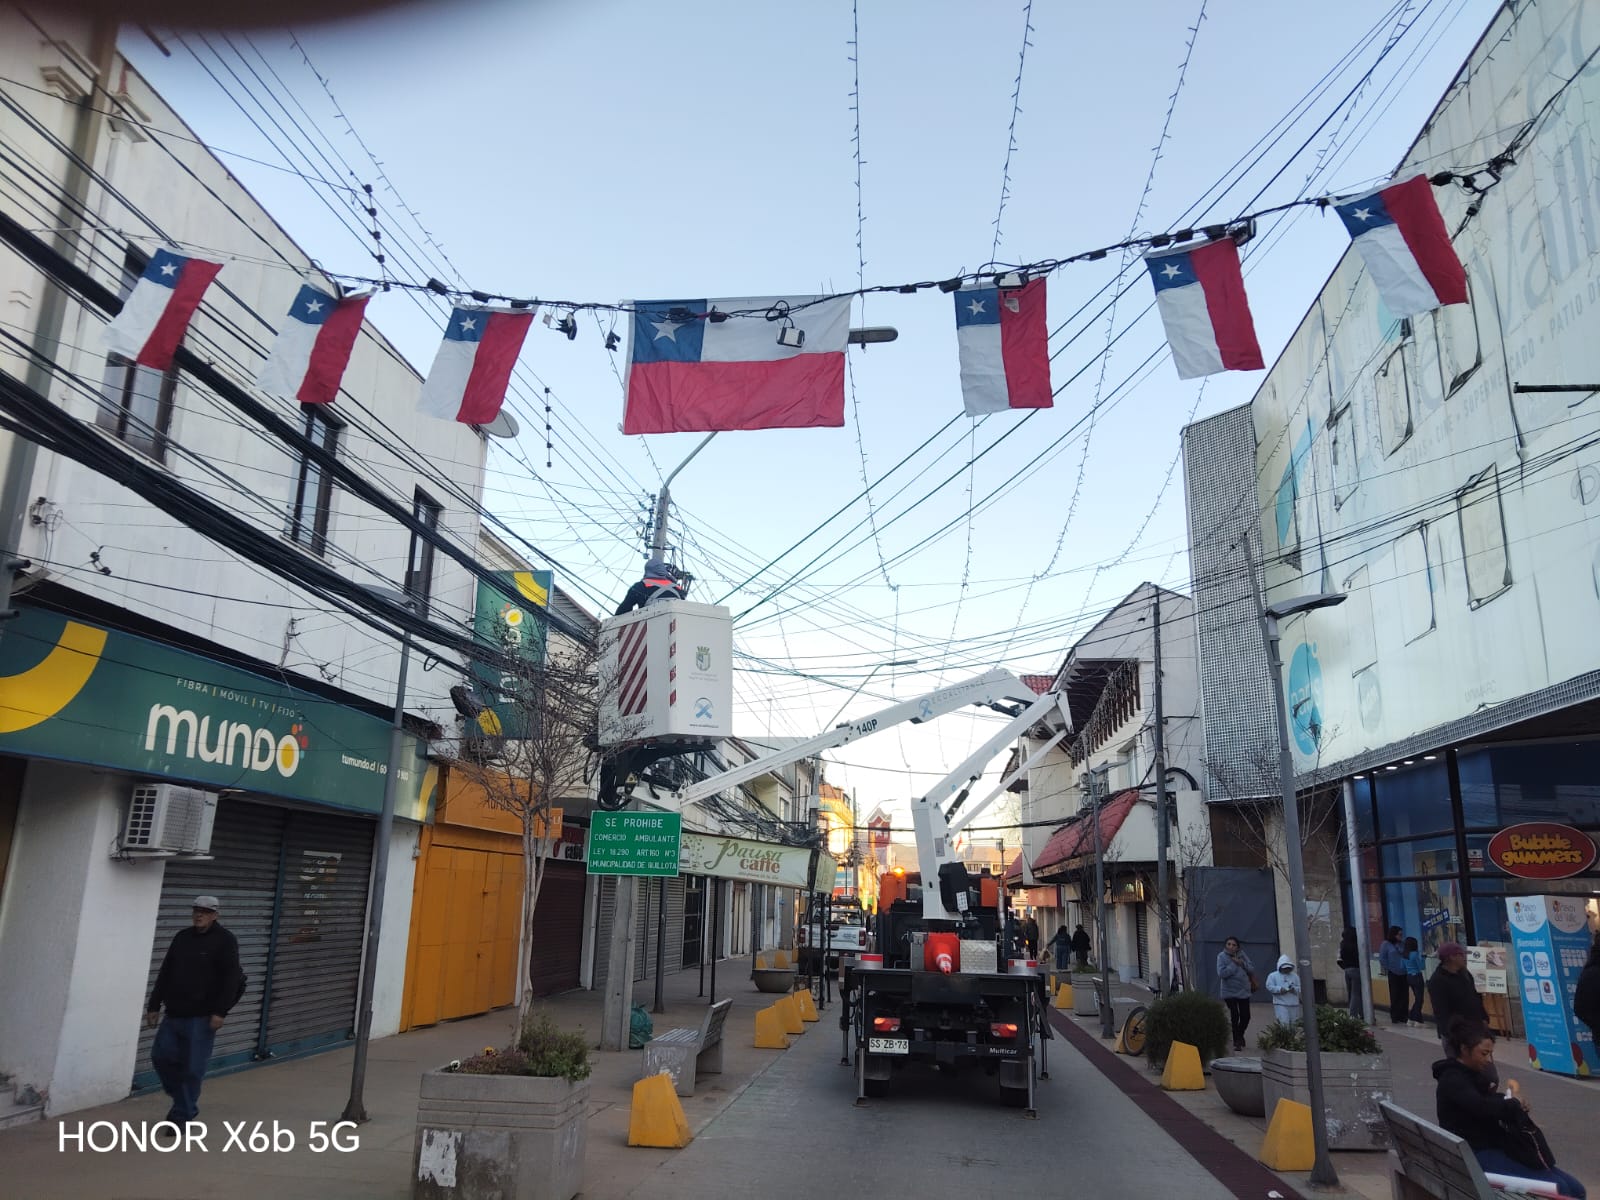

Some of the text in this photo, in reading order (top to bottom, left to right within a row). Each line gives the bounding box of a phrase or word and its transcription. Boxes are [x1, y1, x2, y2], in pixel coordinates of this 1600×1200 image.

[1550, 293, 1584, 341] PATIO
[176, 678, 295, 718] FIBRA MÓVIL TV FIJO
[856, 718, 878, 736] 140P
[341, 753, 376, 772] tumundo.cl
[605, 817, 664, 829] SE PROHIBE
[594, 833, 676, 843] COMERCIO AMBULANTE
[1509, 833, 1572, 850] Bubble
[592, 847, 606, 856] LEY
[1501, 849, 1583, 867] gummers
[637, 861, 647, 869] DE
[647, 862, 677, 870] QUILLOTA
[989, 1046, 1019, 1055] Multicar
